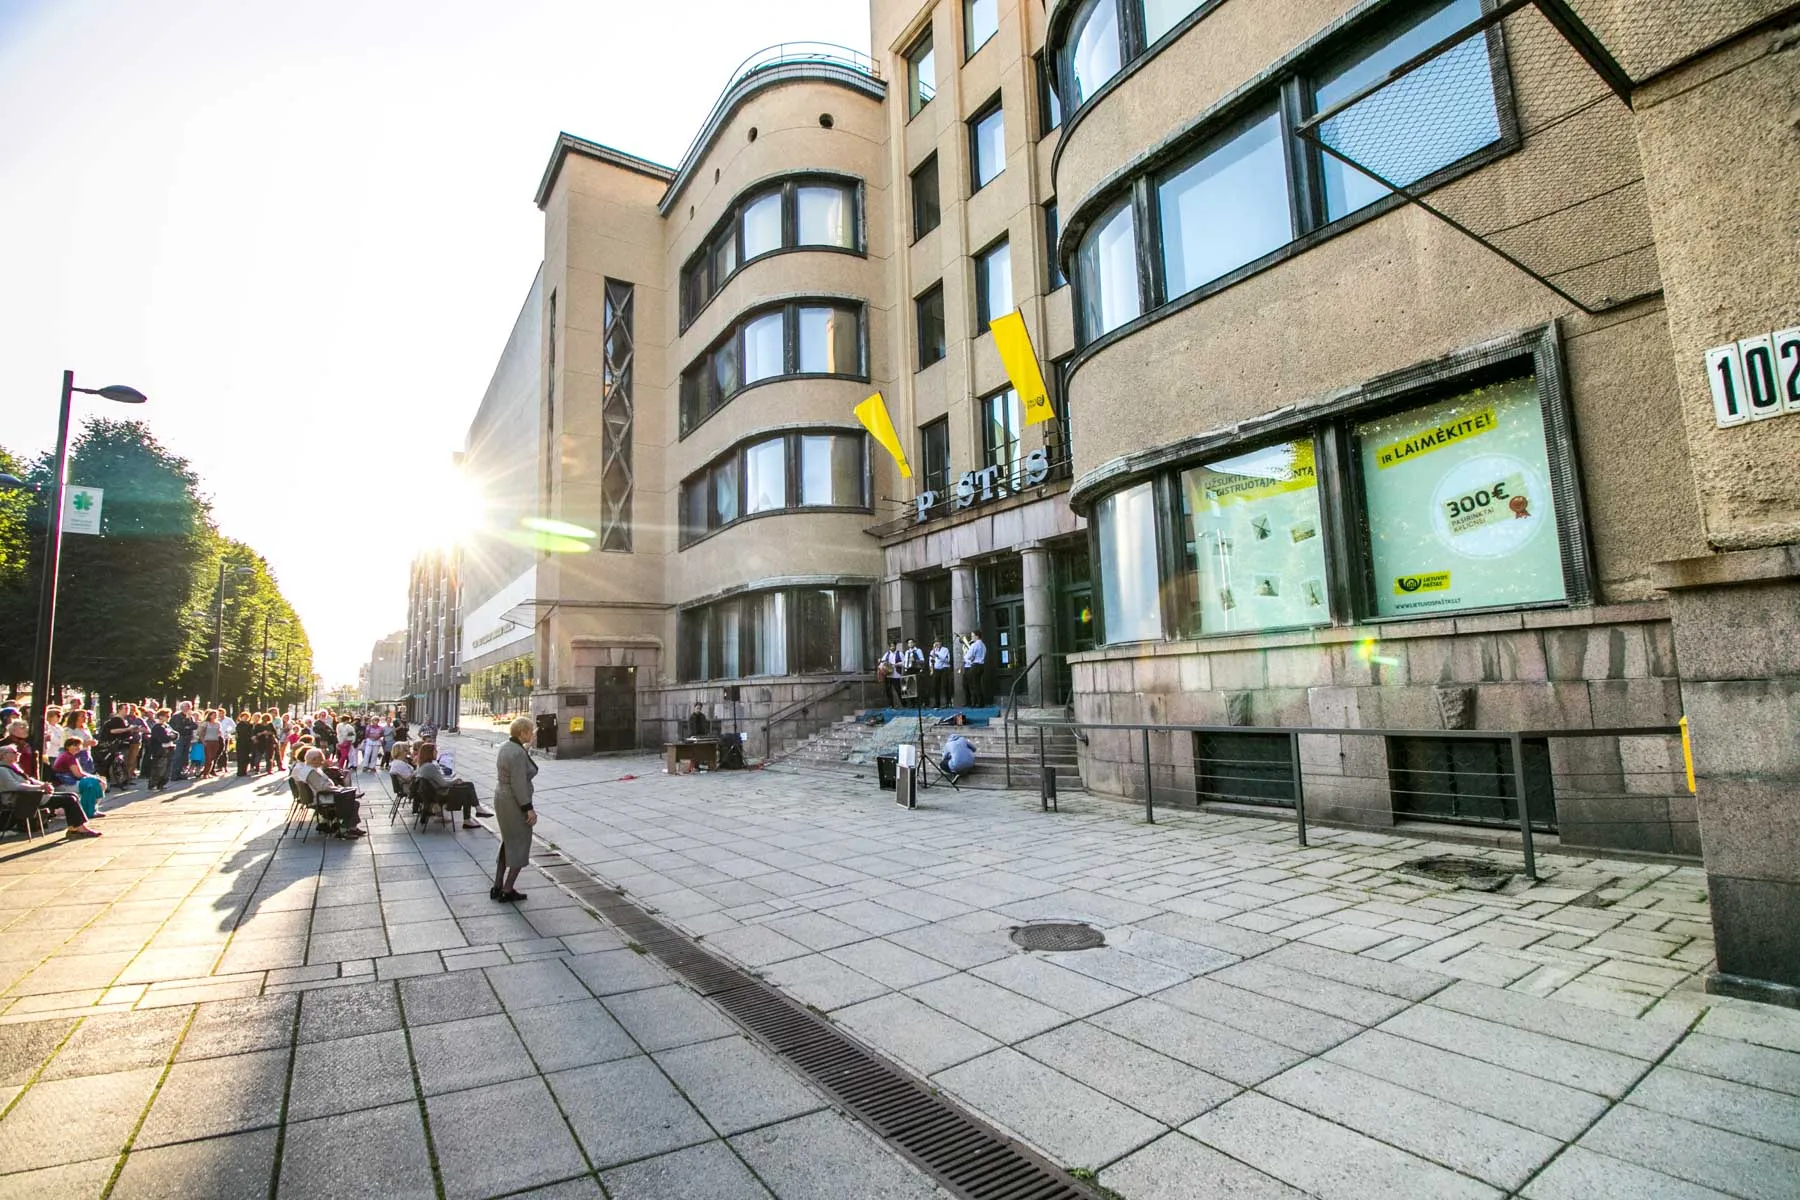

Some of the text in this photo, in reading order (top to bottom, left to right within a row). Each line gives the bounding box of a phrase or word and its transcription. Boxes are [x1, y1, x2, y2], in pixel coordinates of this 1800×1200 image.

[1717, 339, 1800, 416] 102
[1381, 413, 1491, 465] IR LAIMĖKITE!
[916, 448, 1049, 523] PŠTS
